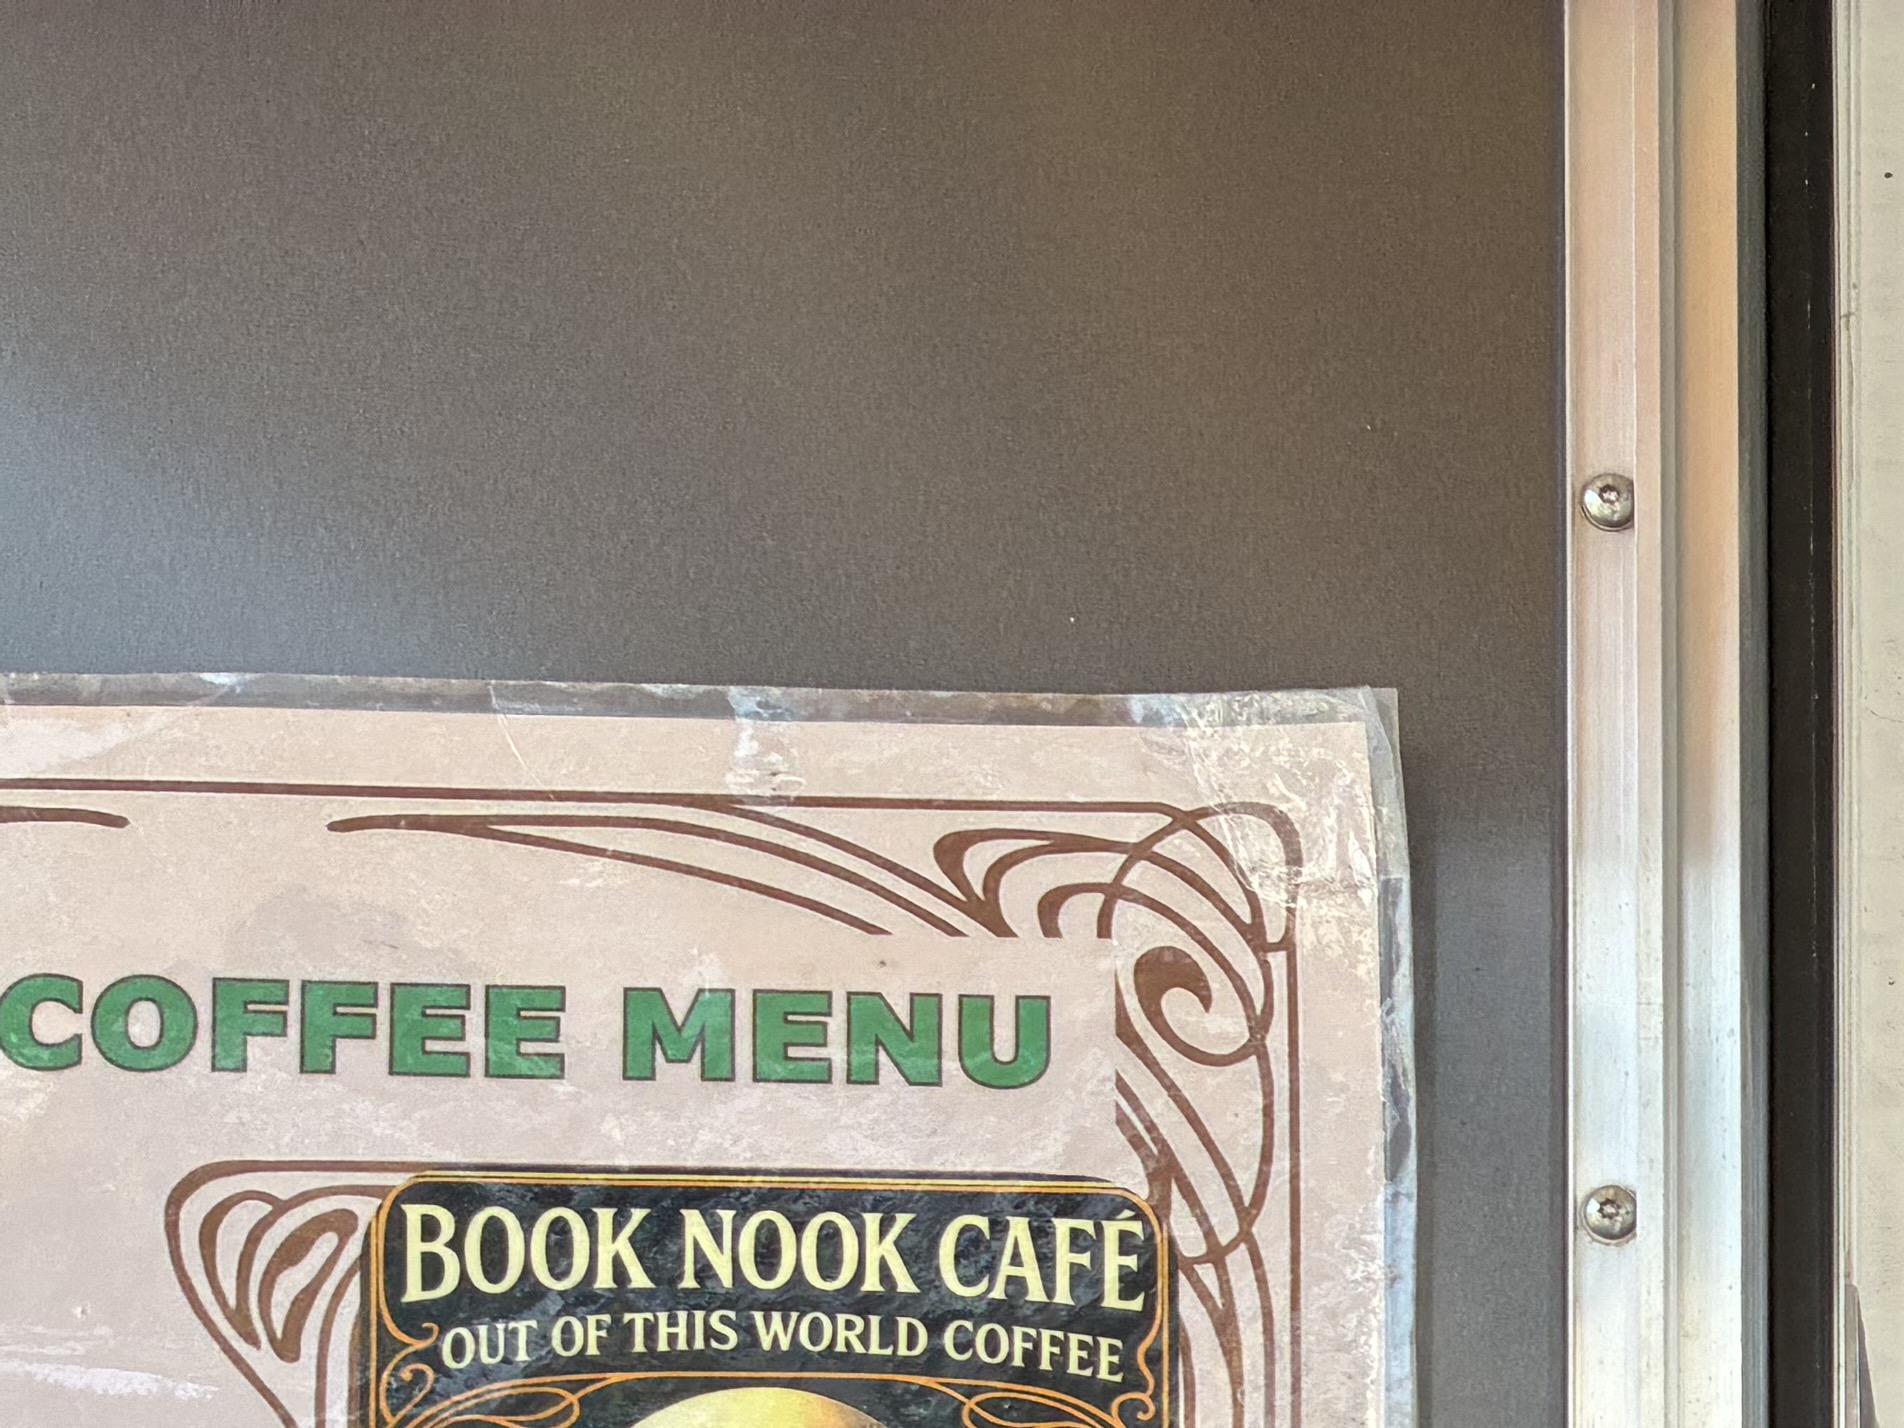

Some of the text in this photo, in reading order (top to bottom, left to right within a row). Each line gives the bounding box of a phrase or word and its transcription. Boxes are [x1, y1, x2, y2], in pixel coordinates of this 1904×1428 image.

[0, 973, 1051, 1088] COFFEE MENU
[400, 1202, 1150, 1312] BOOK NOOK CAFÉ
[441, 1309, 1124, 1383] OUT OF THIS WORLD COFFEE
